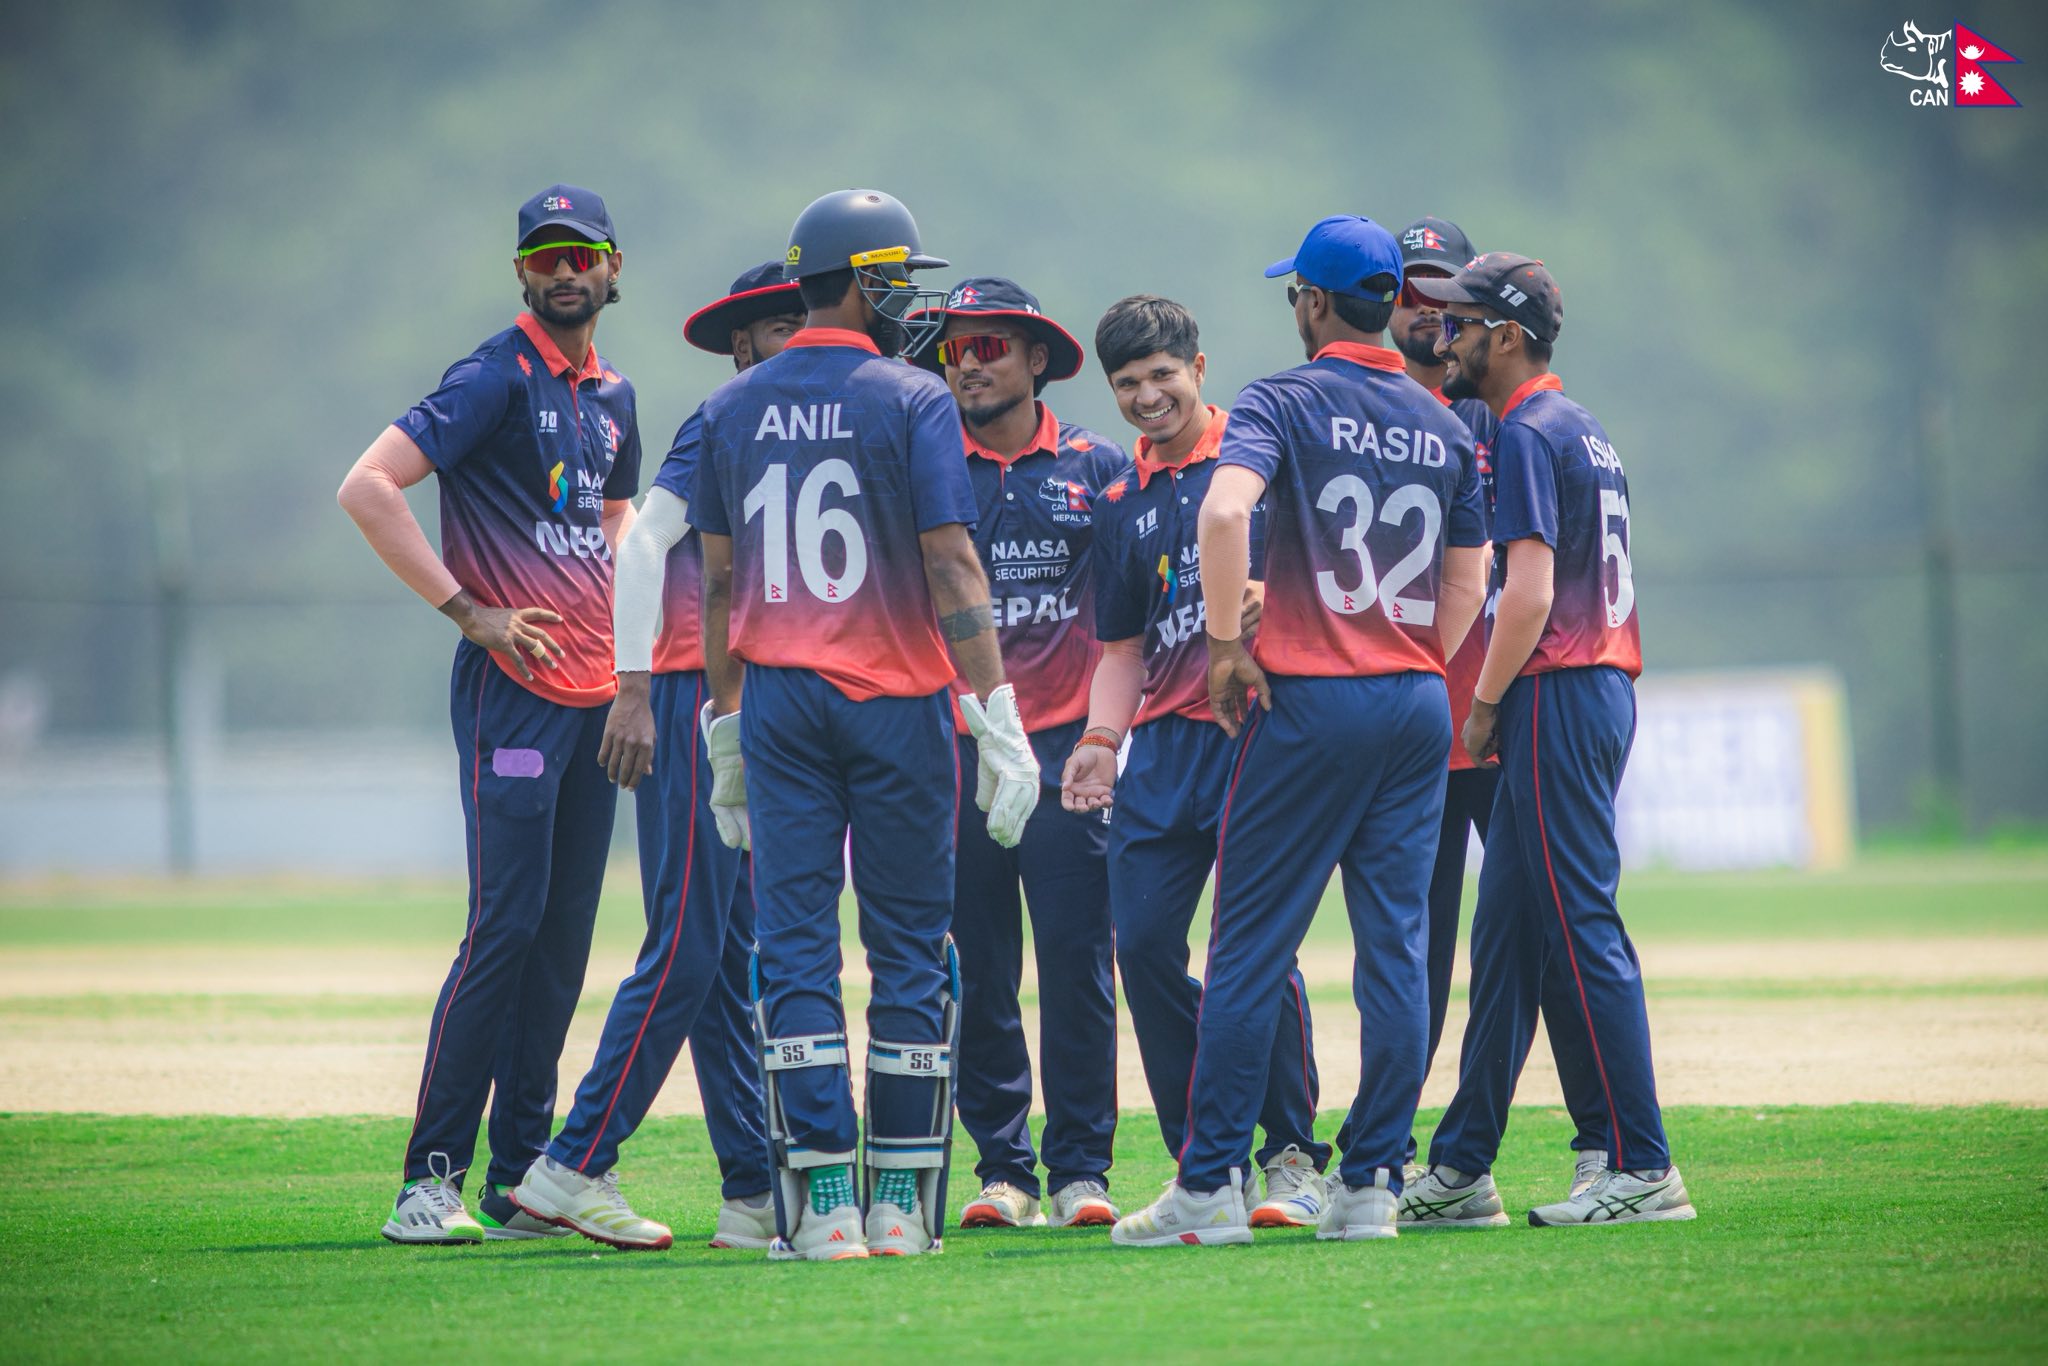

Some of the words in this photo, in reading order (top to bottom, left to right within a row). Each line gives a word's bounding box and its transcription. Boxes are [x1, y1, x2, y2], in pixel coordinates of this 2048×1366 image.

[754, 403, 854, 441] ANIL
[1331, 416, 1447, 468] RASID
[1051, 503, 1068, 511] CAN
[1053, 514, 1081, 522] NEPAL
[743, 458, 868, 604] 16
[991, 539, 1070, 561] NAASA
[1316, 474, 1442, 627] 32
[995, 564, 1068, 581] SECURITIES
[782, 1044, 805, 1064] SS
[910, 1052, 934, 1070] SS
